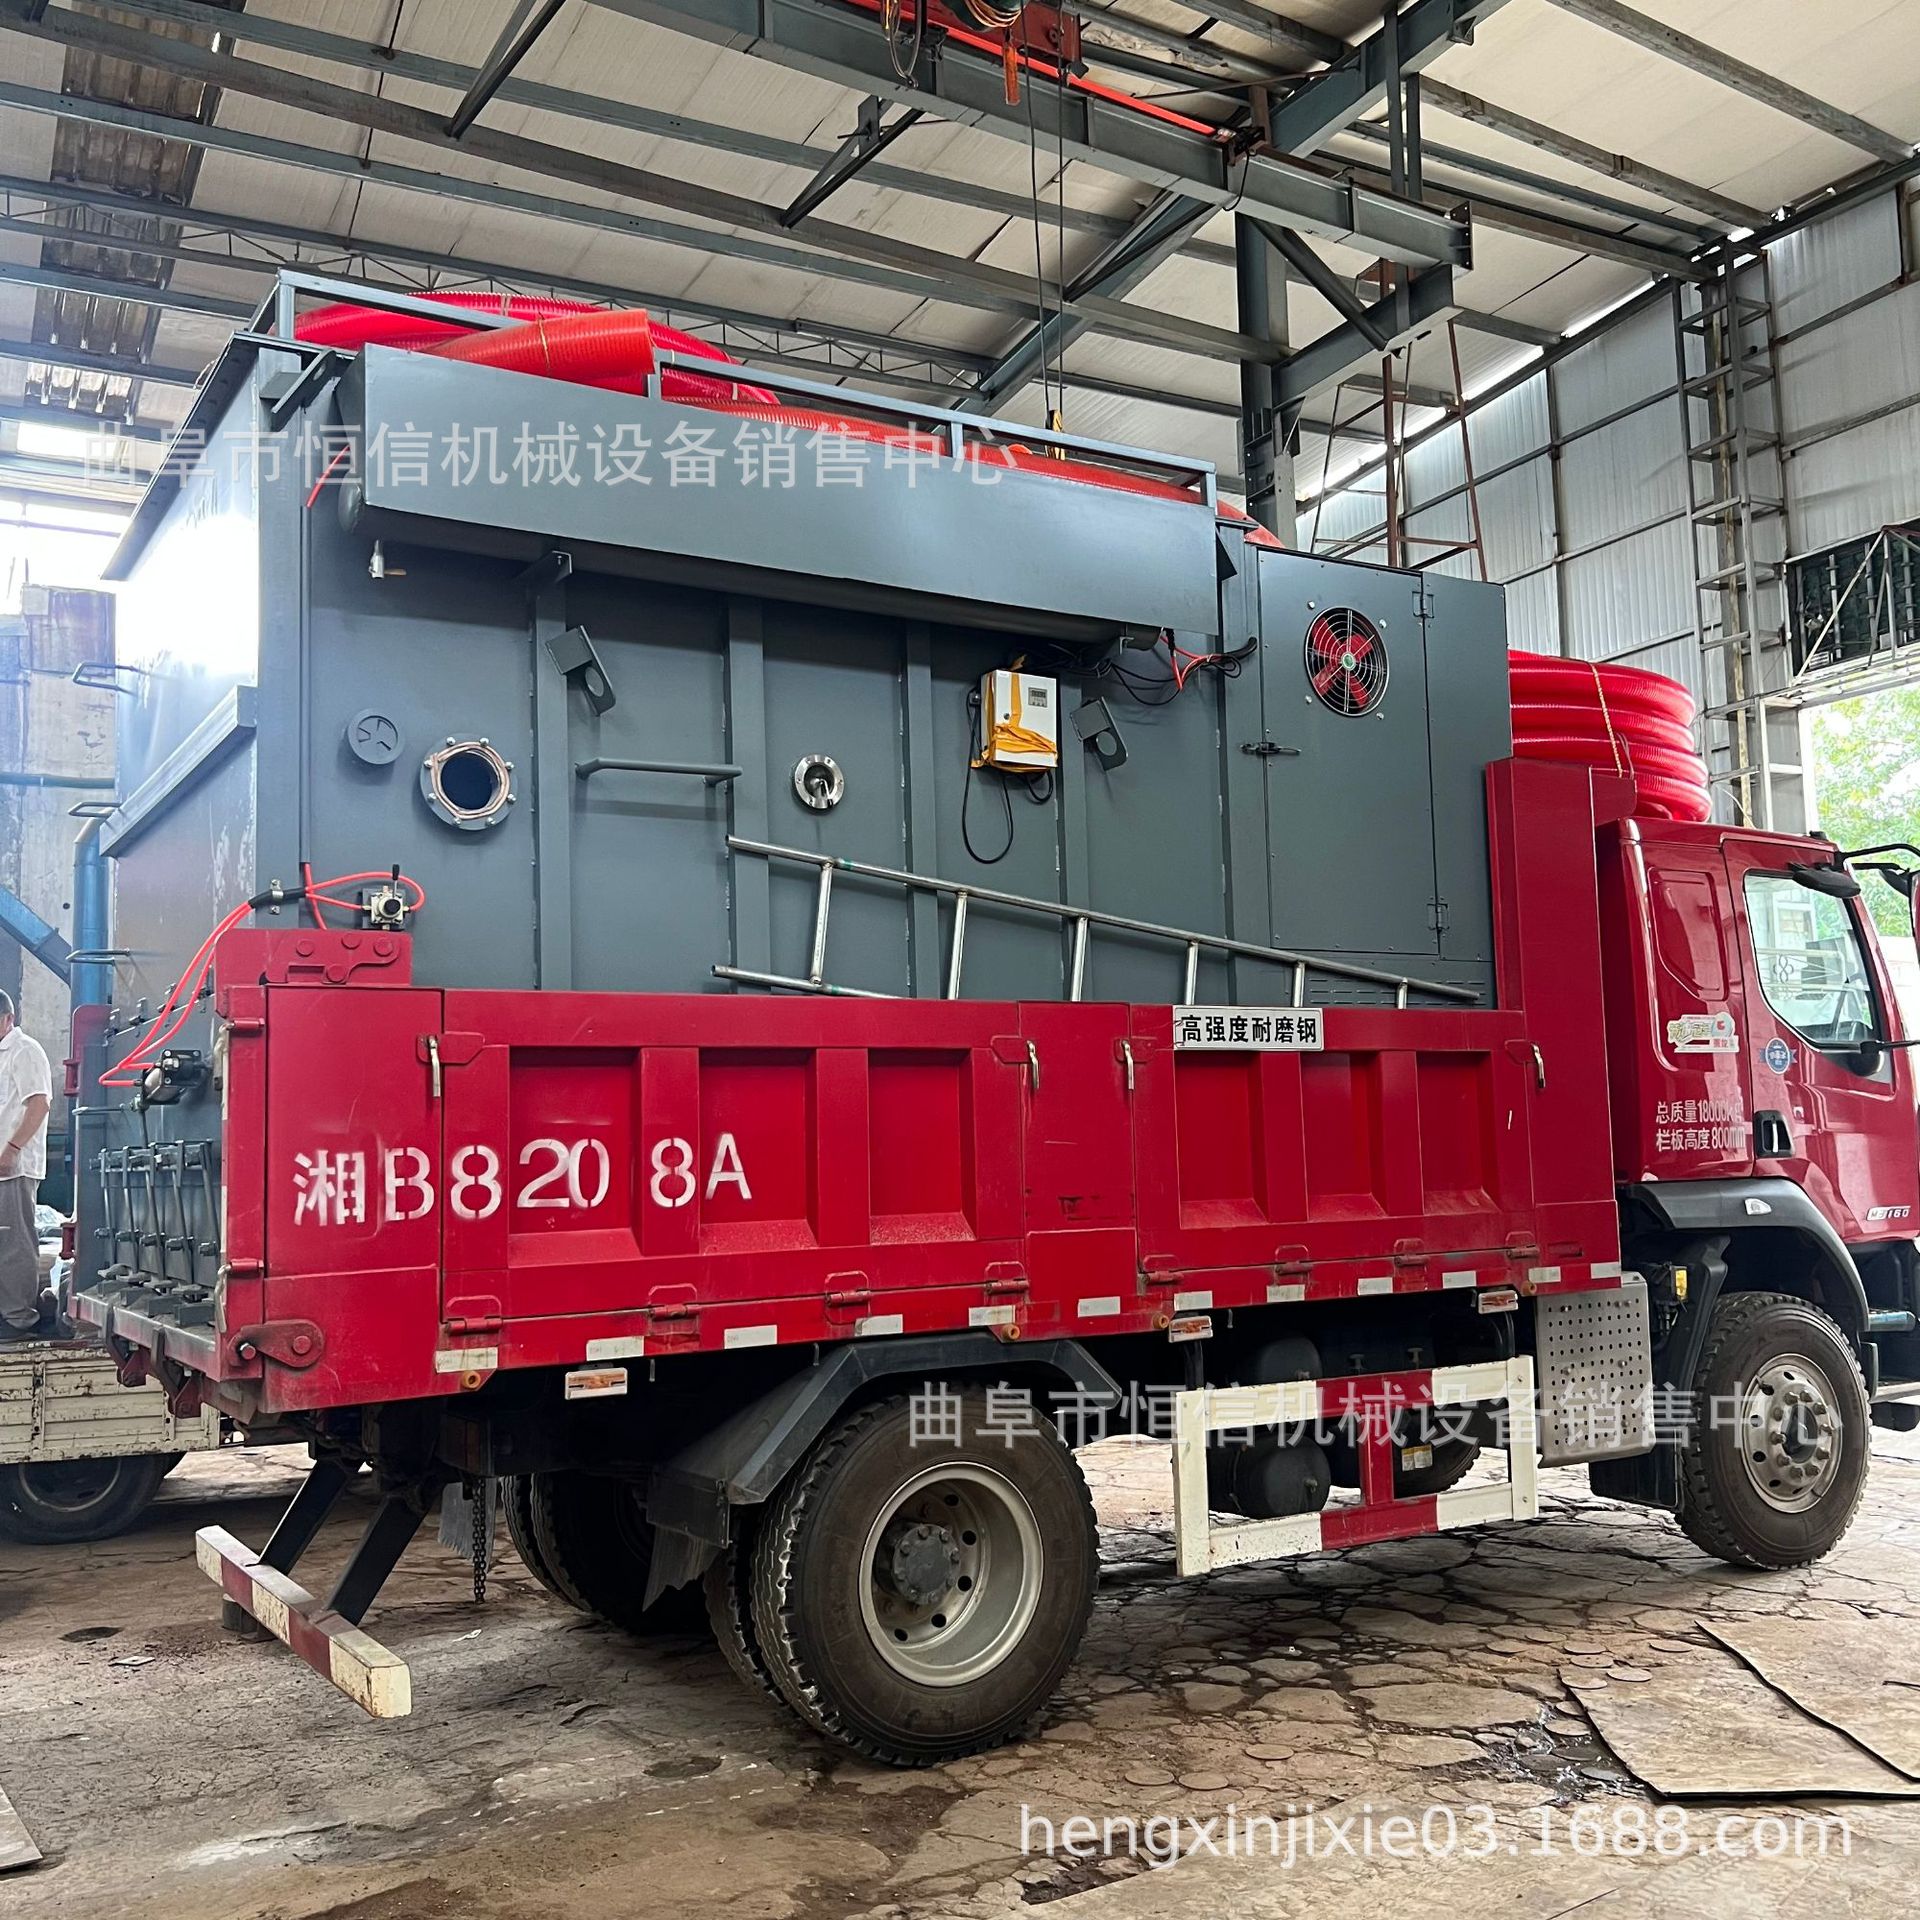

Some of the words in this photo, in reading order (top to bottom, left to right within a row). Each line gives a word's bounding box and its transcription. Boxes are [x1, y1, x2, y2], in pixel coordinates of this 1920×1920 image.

[1181, 1015, 1317, 1044] 高强度耐磨钢
[1656, 1126, 1746, 1152] 栏板高度800mm
